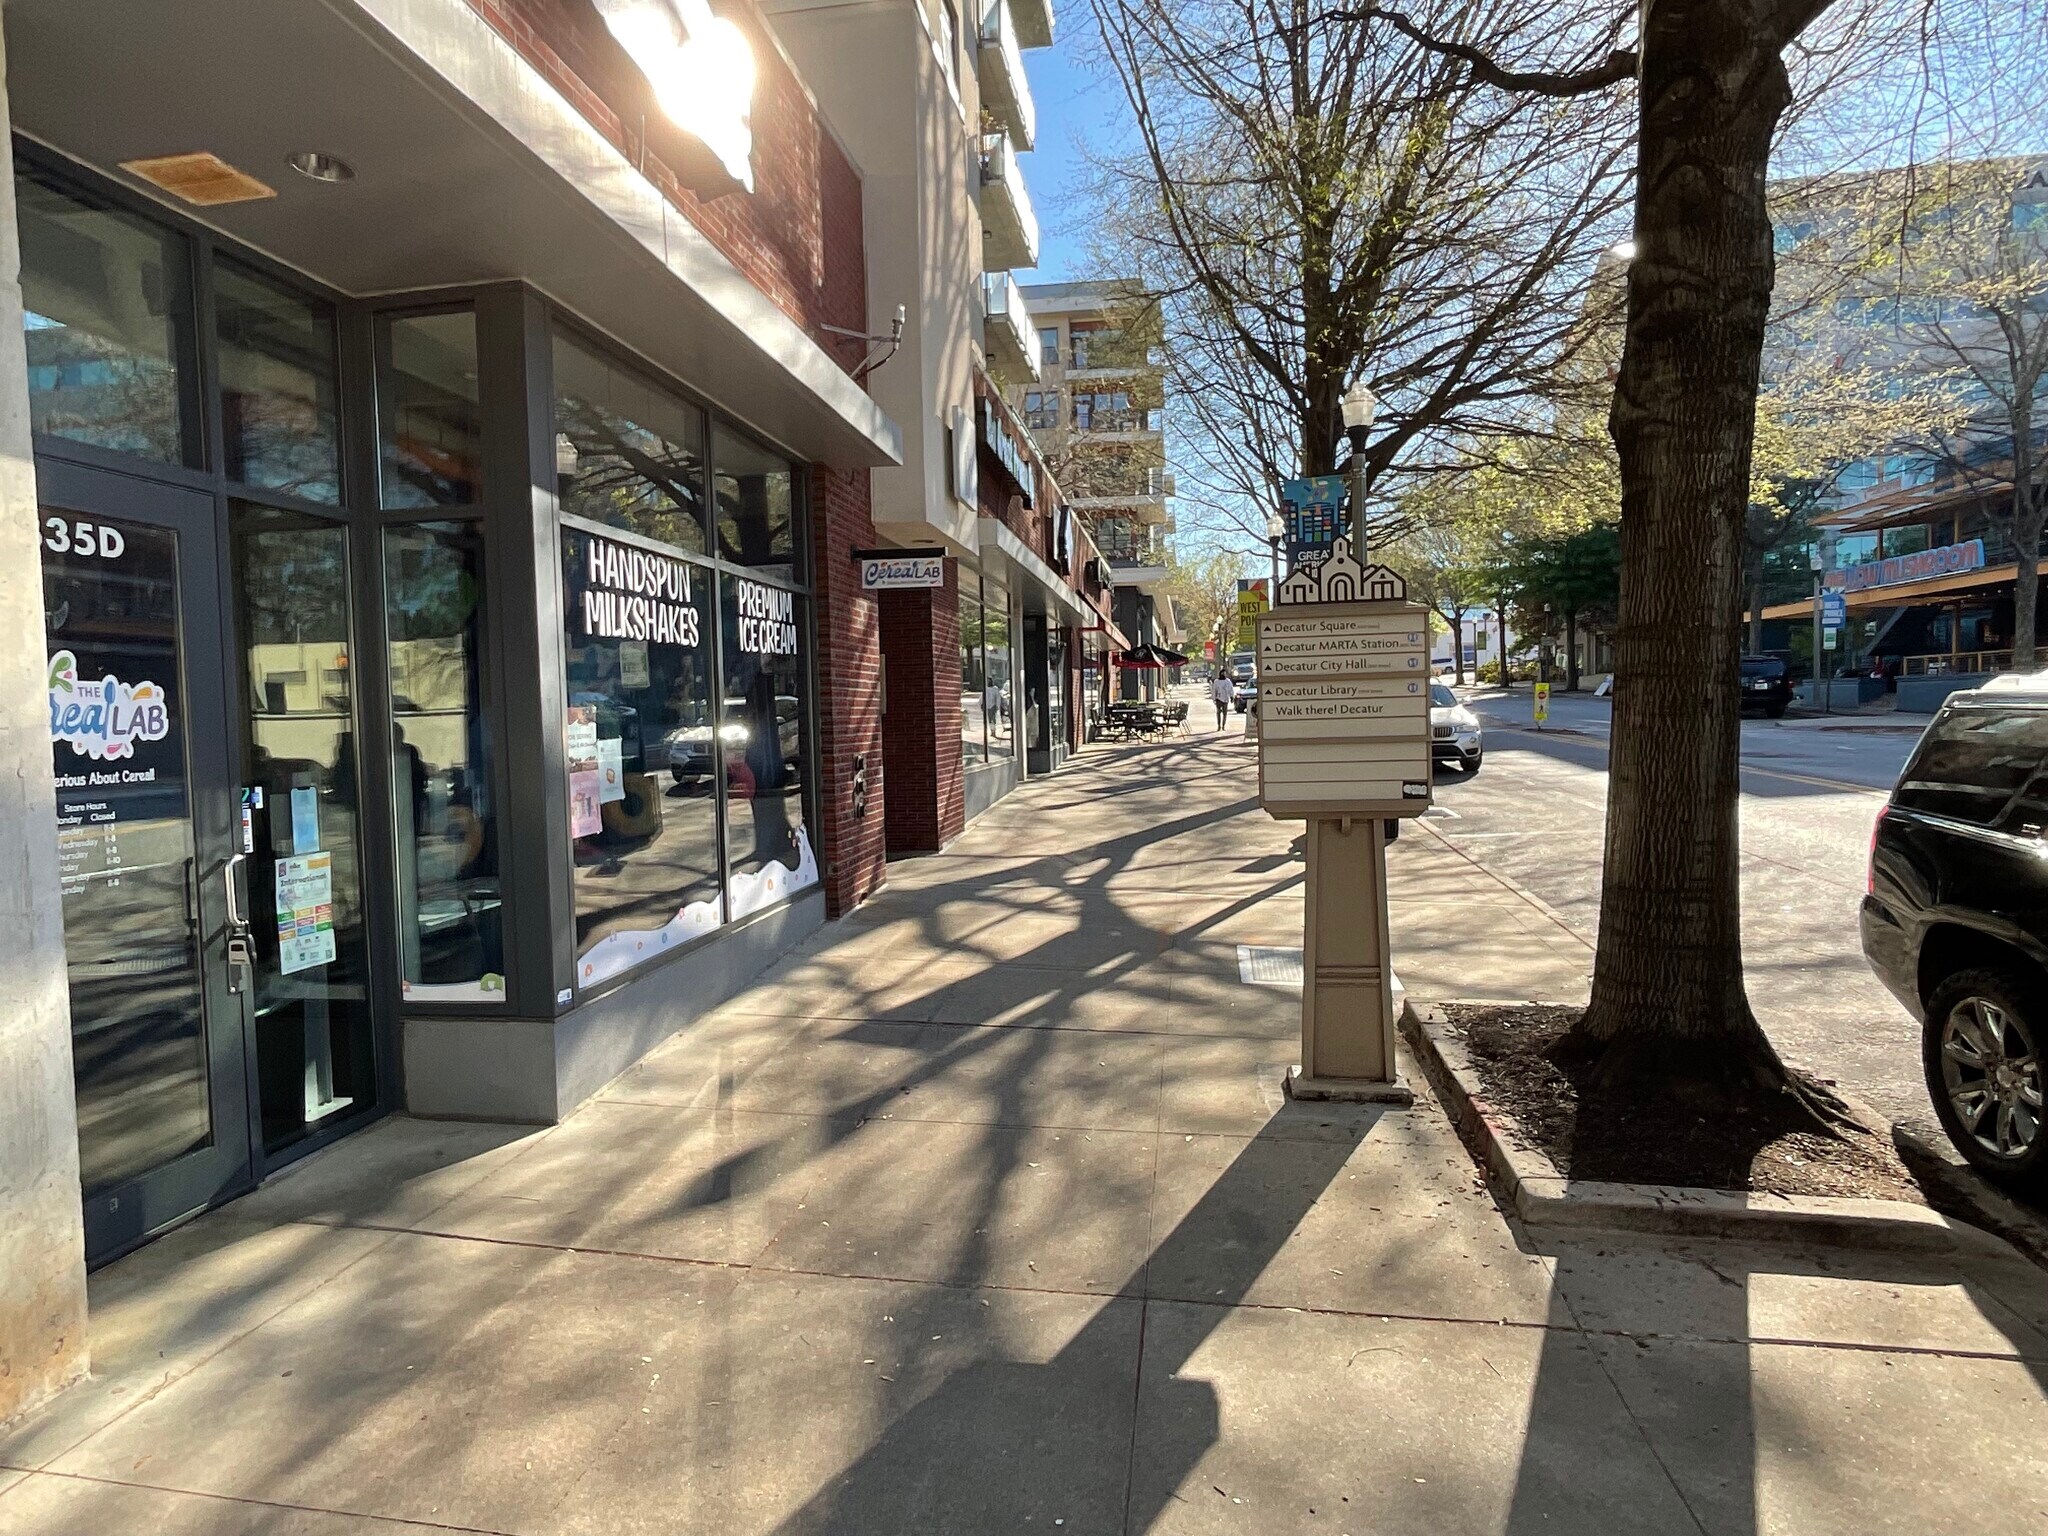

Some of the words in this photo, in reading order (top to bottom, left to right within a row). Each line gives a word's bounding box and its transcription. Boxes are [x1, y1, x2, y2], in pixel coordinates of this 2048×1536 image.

[40, 517, 125, 558] 35D
[588, 539, 691, 603] HANDSPUN
[865, 561, 917, 586] Cereal
[915, 566, 941, 579] LAB
[738, 580, 793, 624] PREMIUM
[1240, 601, 1261, 613] WEST
[585, 590, 700, 648] MILKSHAKES
[1274, 622, 1317, 633] Decatur
[1319, 620, 1357, 633] Square
[739, 616, 759, 653] ICE
[759, 620, 798, 656] CREAM
[1274, 641, 1316, 653] Decatur
[1319, 639, 1358, 650] MARTA
[1361, 638, 1399, 649] Station
[1275, 660, 1317, 672] Decatur
[1320, 659, 1343, 672] City
[1345, 658, 1367, 669] Hall
[77, 686, 101, 698] THE
[1275, 684, 1317, 697] Decatur
[1320, 683, 1358, 697] Library
[1276, 703, 1303, 716] Walk
[1340, 701, 1384, 714] Decatur
[111, 704, 165, 736] LAB
[89, 771, 120, 786] About
[64, 804, 85, 813] Store
[85, 802, 107, 811] Hours
[57, 814, 83, 825] onday
[90, 811, 116, 822] Closed
